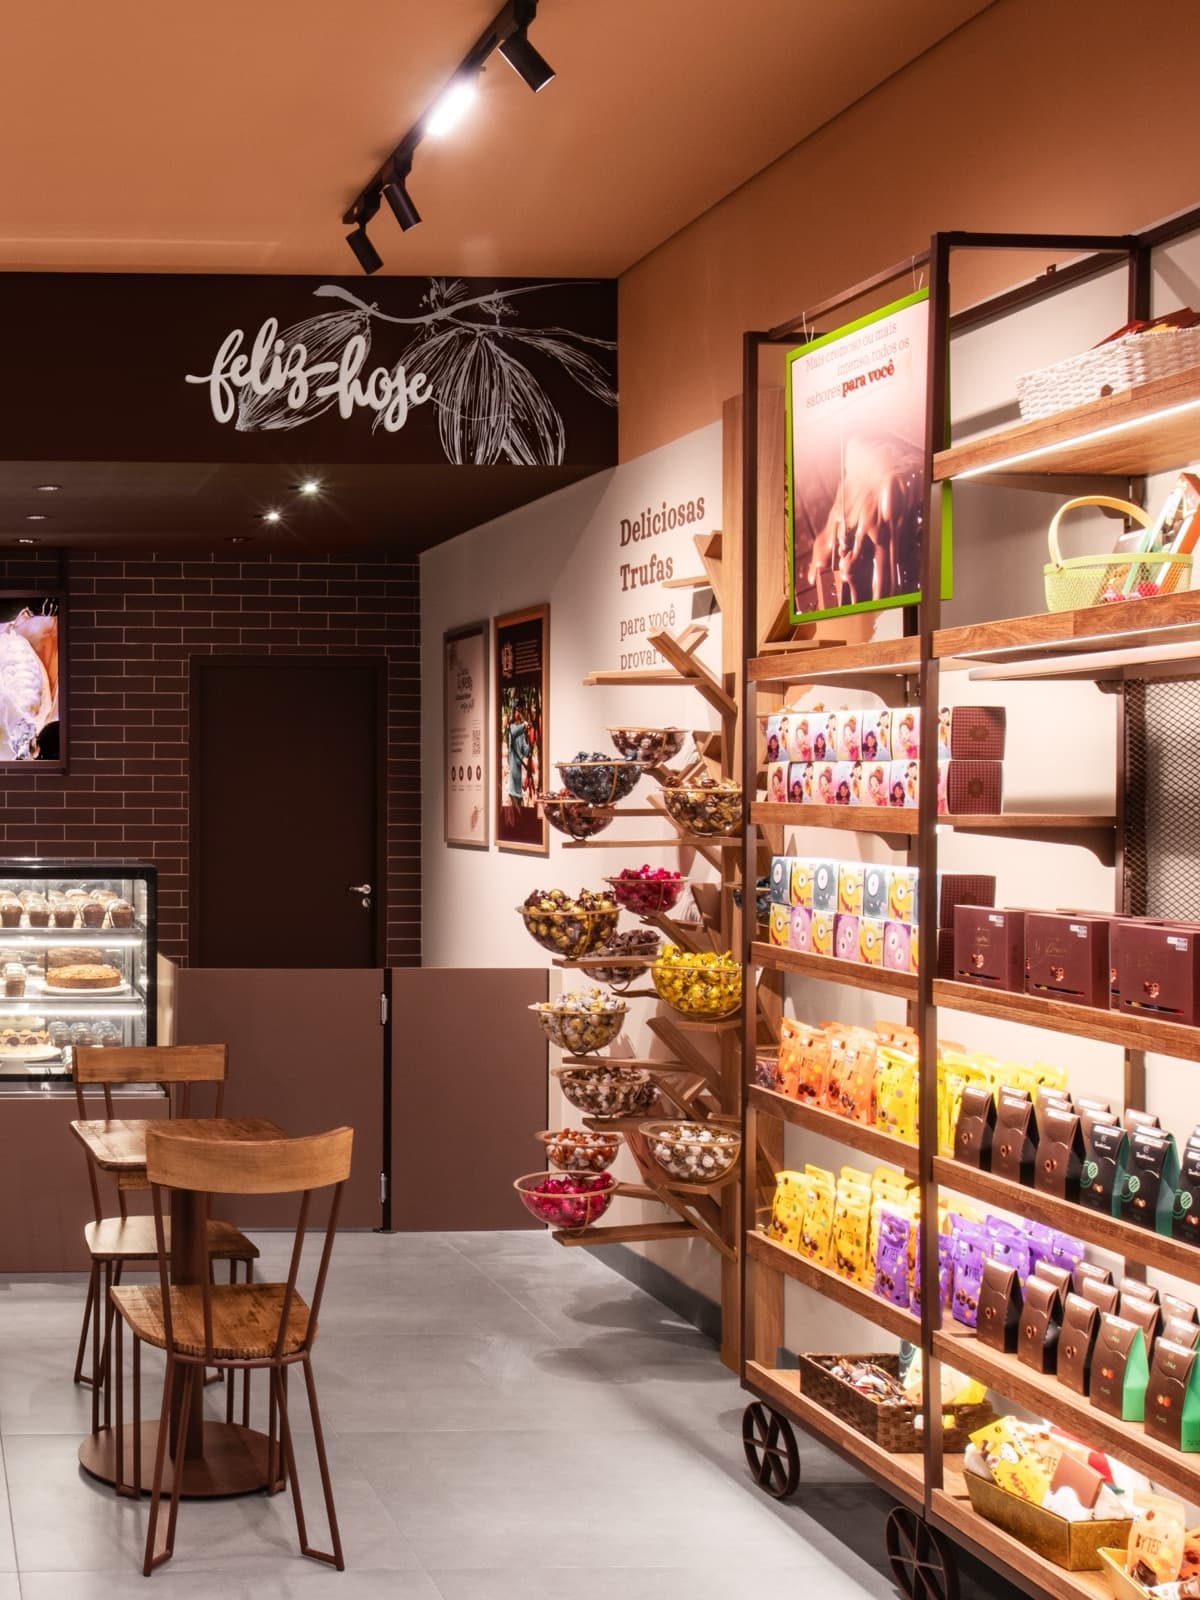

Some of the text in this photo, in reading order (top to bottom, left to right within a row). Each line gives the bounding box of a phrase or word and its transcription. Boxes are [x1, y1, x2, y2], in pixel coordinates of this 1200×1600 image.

[316, 335, 433, 432] hoje
[842, 375, 866, 398] para
[867, 358, 895, 383] você
[620, 497, 705, 547] Deliciosas
[620, 553, 674, 592] Trufas
[620, 603, 676, 642] para você
